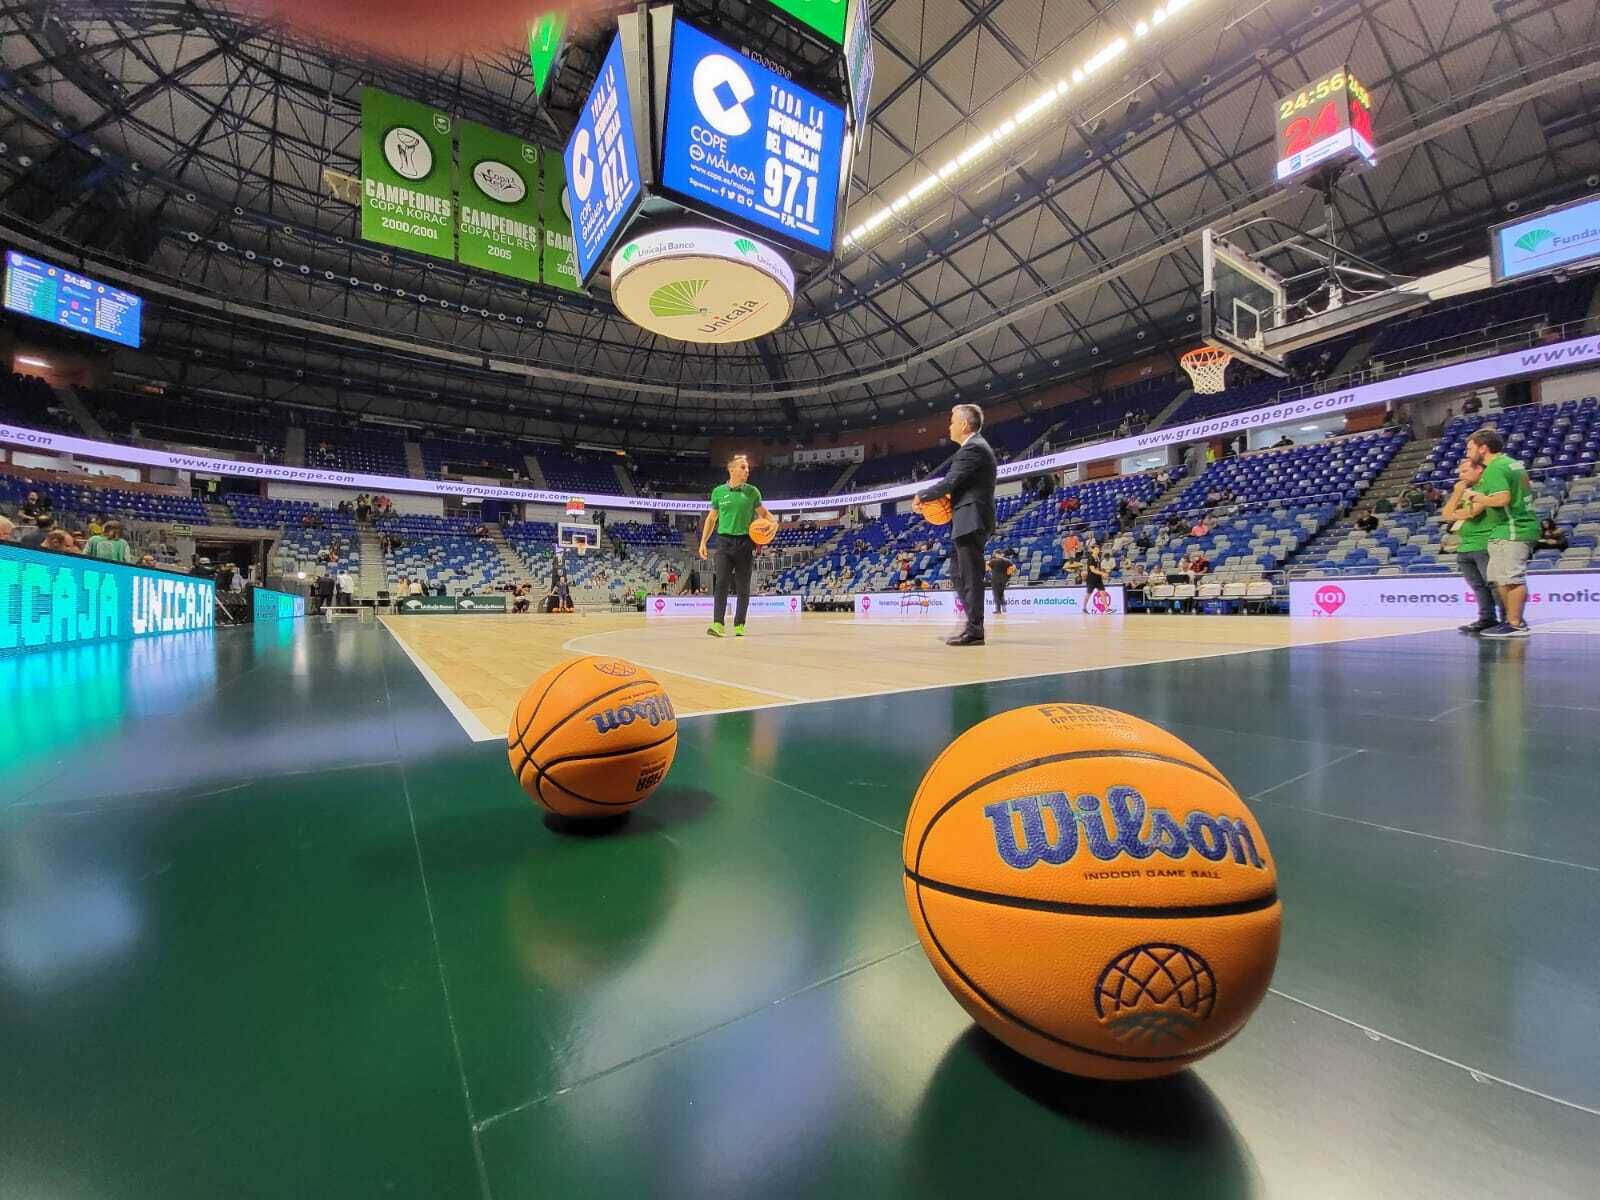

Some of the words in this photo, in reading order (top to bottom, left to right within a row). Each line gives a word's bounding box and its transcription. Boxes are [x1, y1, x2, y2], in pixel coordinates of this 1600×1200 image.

[770, 84, 801, 119] TODA
[809, 106, 823, 130] LA
[1280, 73, 1345, 120] 24:56
[690, 125, 727, 154] COPE
[706, 152, 755, 185] MÁLAGA
[365, 178, 451, 217] CAMPEONES
[763, 156, 818, 224] 97.1
[370, 198, 404, 216] COPA
[406, 207, 448, 226] KORAC
[462, 206, 537, 243] CAMPEONES
[382, 217, 438, 240] 2000/2001
[460, 223, 491, 240] COPA
[492, 232, 515, 246] DEL
[516, 239, 537, 253] REY
[1552, 228, 1600, 247] Funda
[487, 245, 513, 260] 2005
[668, 241, 696, 250] Banco
[697, 300, 760, 333] Unicaja
[1136, 393, 1355, 447] www.grupopacopepe.com
[168, 455, 355, 484] www.grupopacopepe.com
[435, 483, 568, 501] www.grupopacopepe.com
[132, 576, 214, 635] UNICAJA
[1021, 598, 1032, 606] de
[1316, 592, 1343, 604] 101
[1380, 592, 1459, 604] tenemos
[983, 784, 1267, 871] Wilson
[1084, 870, 1141, 881] INDOOR
[1146, 869, 1186, 878] GAME
[1191, 870, 1222, 880] BALL
